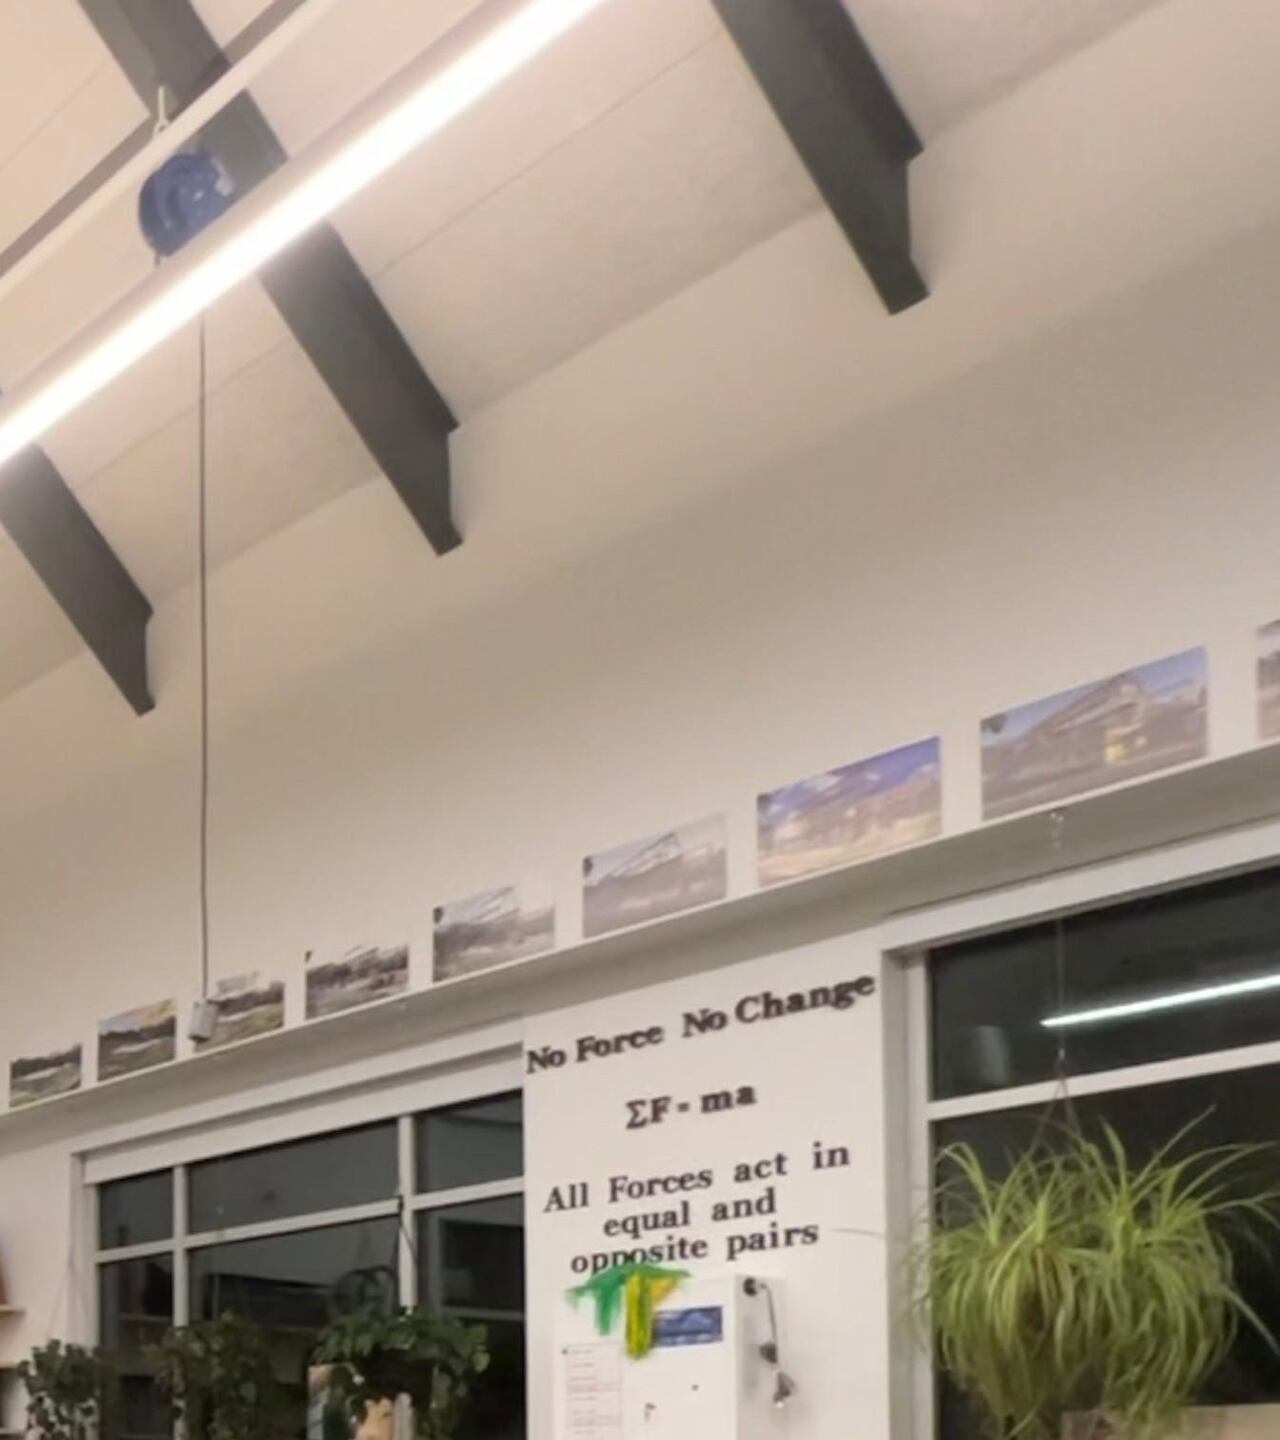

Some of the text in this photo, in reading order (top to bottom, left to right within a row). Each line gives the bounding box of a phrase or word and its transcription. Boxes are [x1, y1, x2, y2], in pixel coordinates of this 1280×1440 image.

[525, 974, 876, 1074] No Force No Change
[699, 1084, 758, 1115] ma
[542, 1140, 851, 1214] All Forces act in
[602, 1186, 778, 1240] equal and
[725, 1221, 820, 1262] pairs
